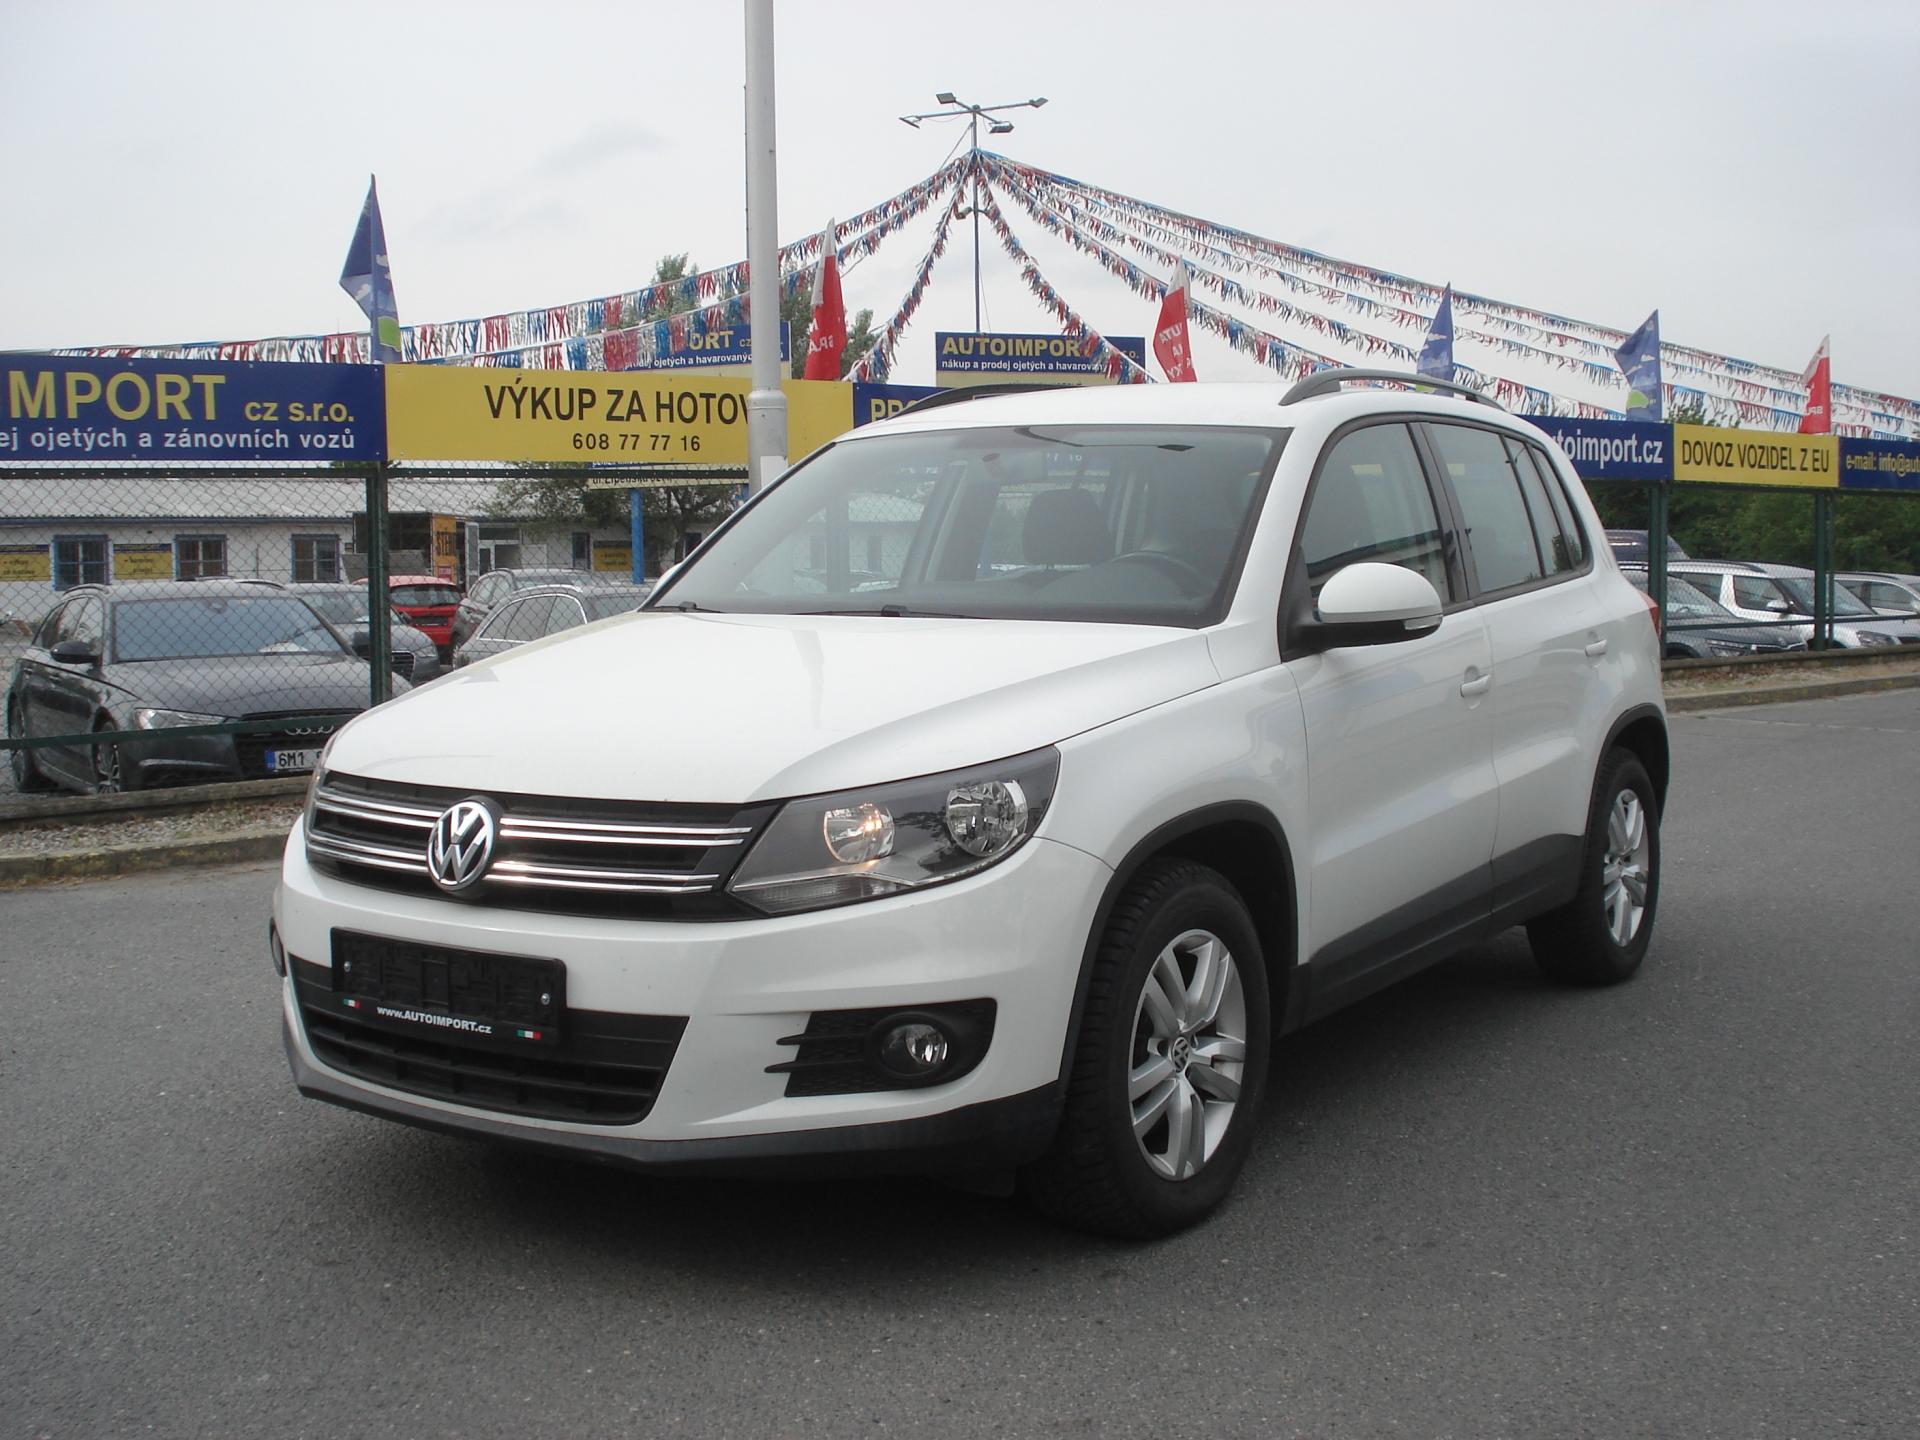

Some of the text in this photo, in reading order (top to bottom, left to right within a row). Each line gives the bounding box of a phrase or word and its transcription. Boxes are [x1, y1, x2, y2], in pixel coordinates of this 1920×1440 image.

[943, 337, 1092, 357] AUTOIMPOR
[654, 354, 685, 367] ojetých
[688, 357, 694, 365] a
[942, 360, 971, 370] nákup
[982, 360, 1010, 371] prodej
[1013, 360, 1046, 371] ojetých
[8, 371, 354, 422] MPORT cz s.r.o.
[484, 377, 597, 421] VÝKUP
[606, 389, 647, 422] ZA
[31, 427, 127, 451] ojetých
[138, 432, 152, 448] a
[164, 428, 289, 449] zánovních
[300, 428, 354, 449] vozů
[573, 433, 700, 451] 608 77 77 16
[1552, 428, 1664, 470] toimport.cz
[1682, 440, 1830, 473] DOVOZ VOZIDEL Z EU
[1845, 451, 1878, 471] e-mail:
[376, 1006, 492, 1035] www.AUTOIMPORT.cz
